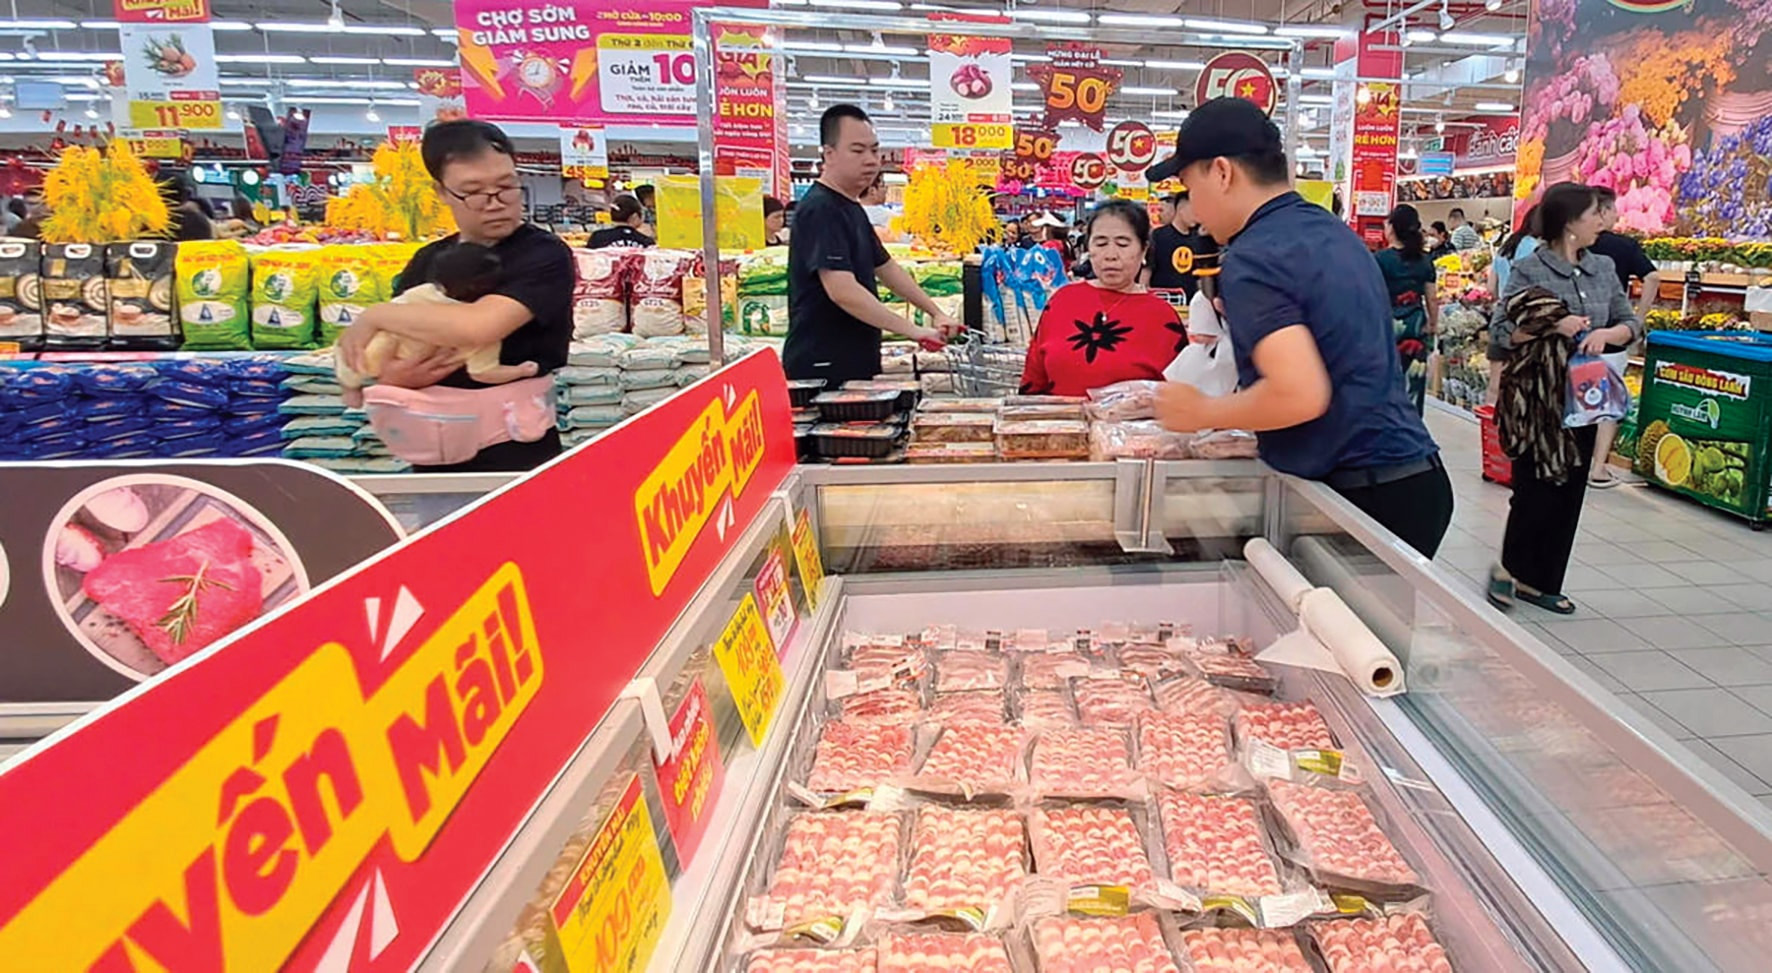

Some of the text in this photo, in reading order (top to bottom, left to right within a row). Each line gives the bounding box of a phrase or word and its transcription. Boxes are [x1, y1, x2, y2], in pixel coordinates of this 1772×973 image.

[477, 3, 576, 28] CHỢ SỚM
[649, 12, 683, 22] 10:00
[472, 23, 591, 46] GIẢM SUNG
[609, 53, 697, 86] GIẢM 10
[733, 103, 774, 118] HƠN
[1371, 134, 1397, 146] HƠN
[642, 415, 727, 570] Khuyến
[729, 395, 762, 484] Mãi!
[387, 582, 536, 826] Mãi!
